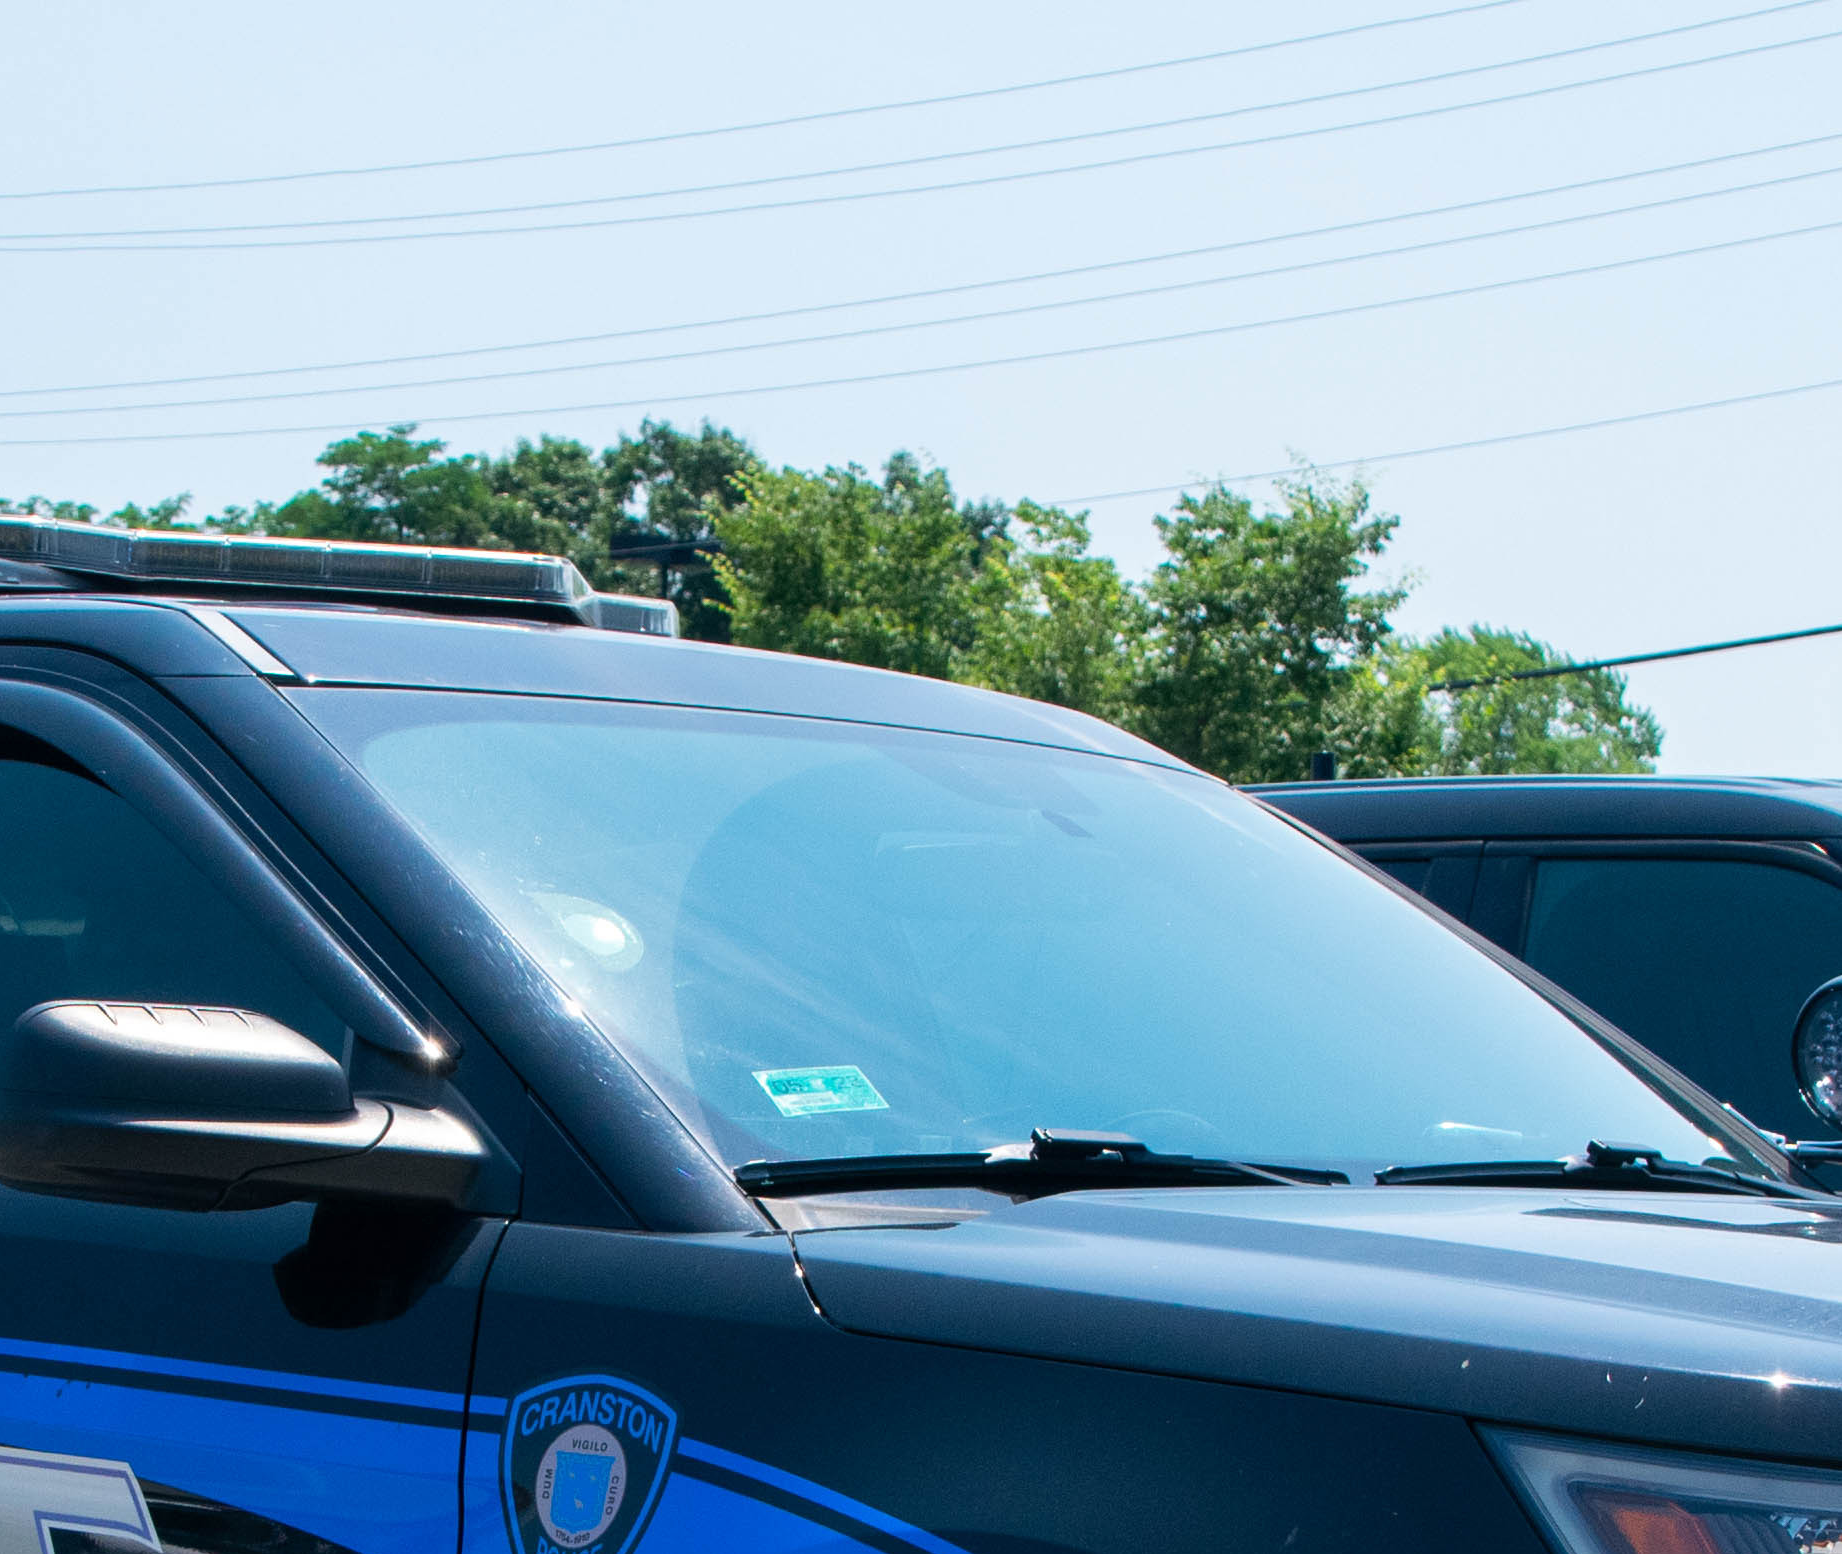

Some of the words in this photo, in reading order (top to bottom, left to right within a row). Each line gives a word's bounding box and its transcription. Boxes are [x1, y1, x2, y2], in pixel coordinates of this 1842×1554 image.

[521, 1391, 663, 1454] CRANSTON
[572, 1439, 608, 1452] VIGILO
[605, 1475, 620, 1516] CURO
